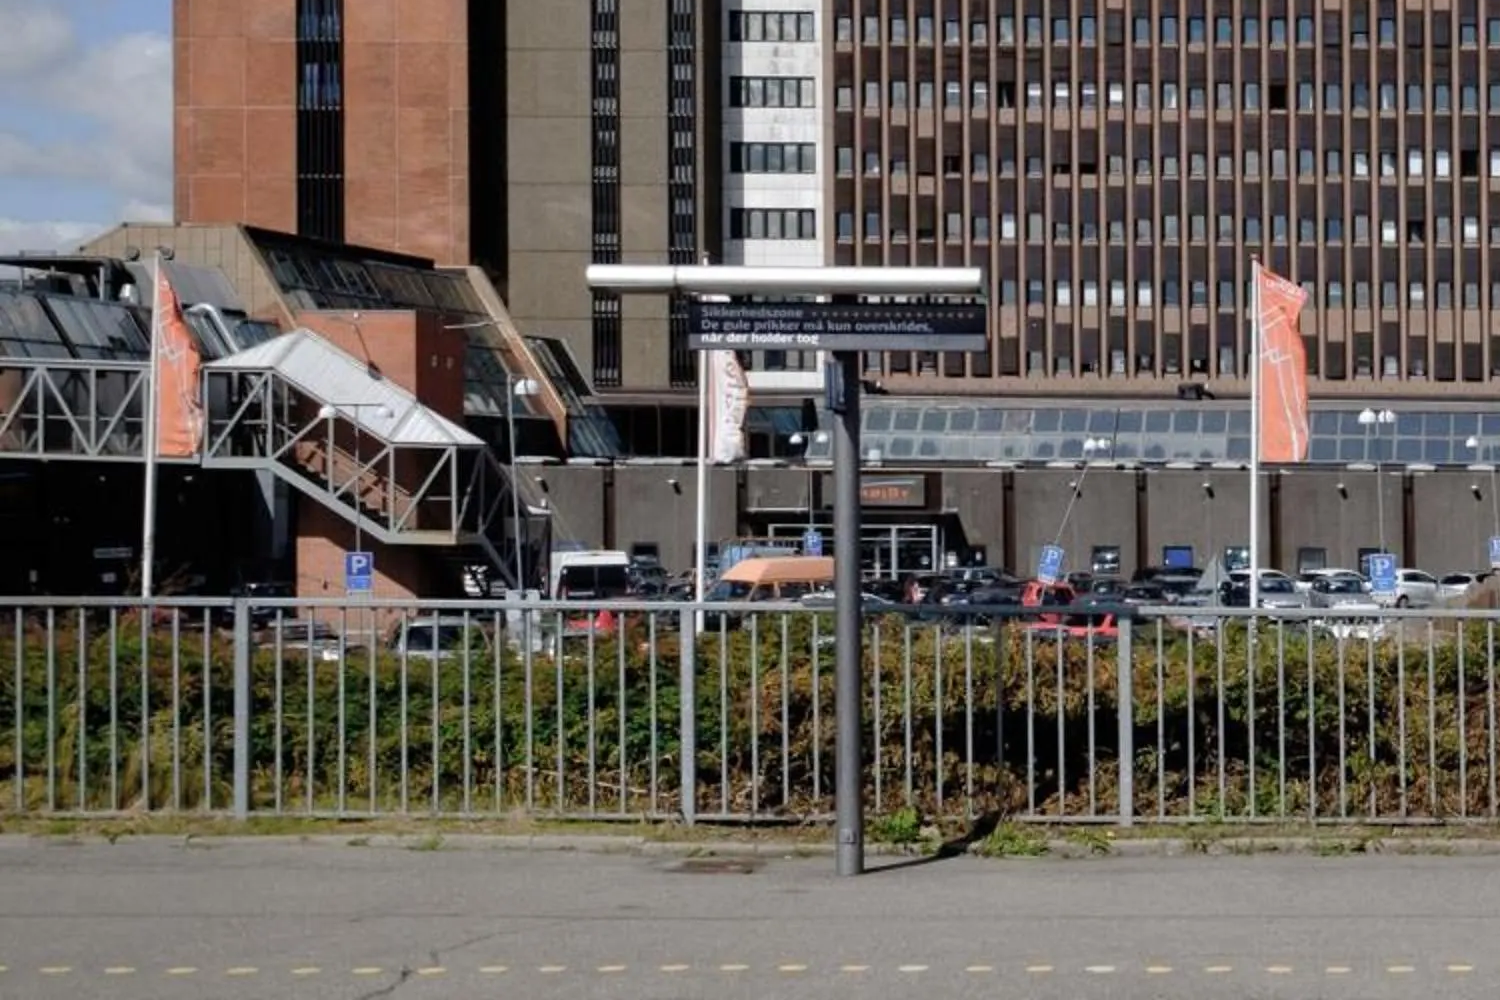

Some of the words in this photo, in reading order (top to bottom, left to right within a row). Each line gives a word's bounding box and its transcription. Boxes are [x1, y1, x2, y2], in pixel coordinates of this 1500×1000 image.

[701, 306, 804, 318] Sikkerhedszone
[701, 319, 719, 331] De
[722, 319, 750, 333] gule
[753, 319, 800, 333] prikker
[827, 320, 851, 332] kun
[701, 332, 722, 343] når
[726, 332, 748, 343] der
[752, 332, 793, 343] holder
[797, 333, 819, 345] tog
[1045, 549, 1058, 564] P
[351, 555, 367, 574] P
[1374, 558, 1389, 577] P
